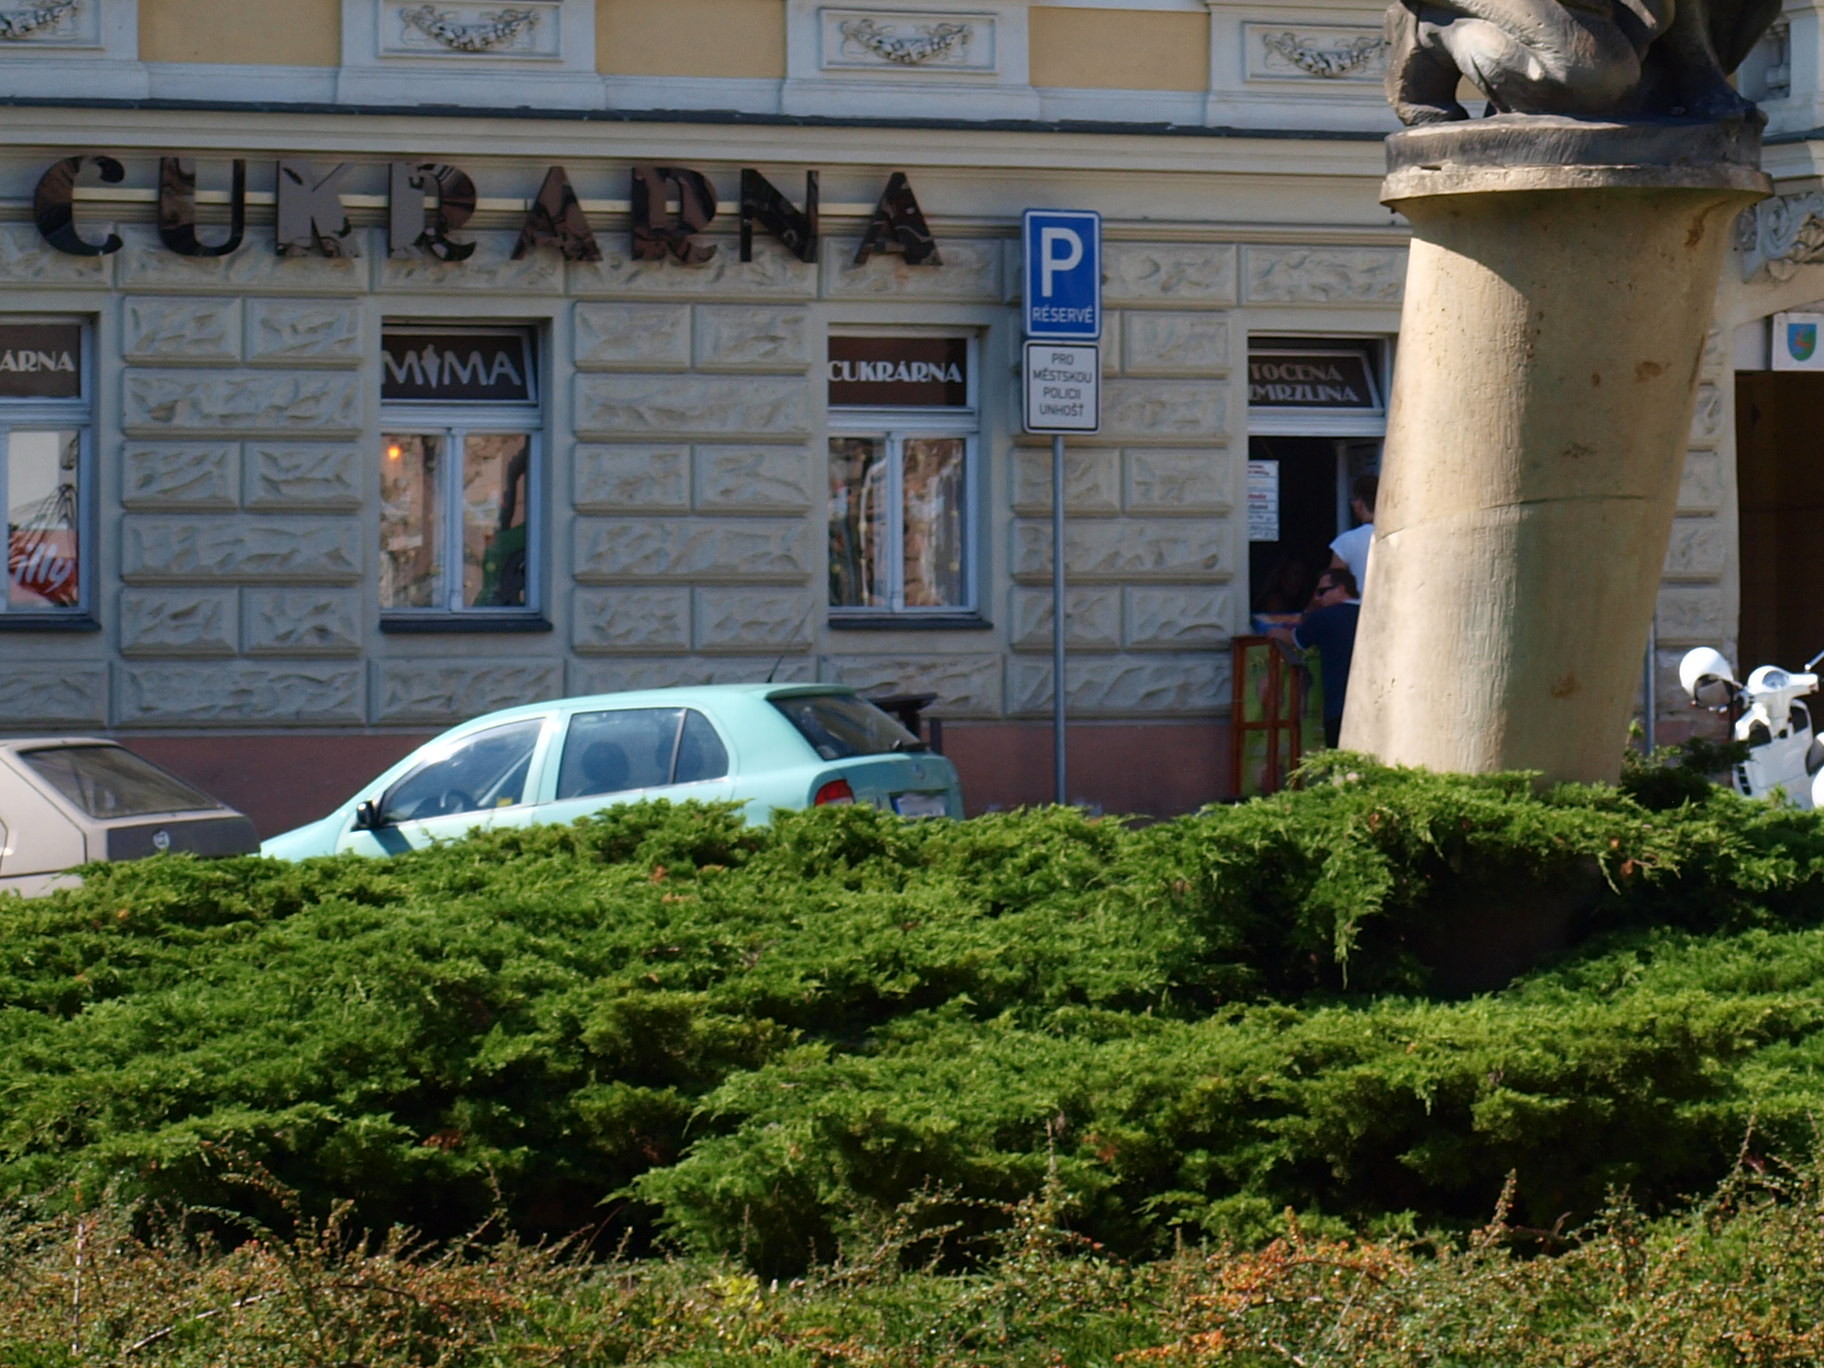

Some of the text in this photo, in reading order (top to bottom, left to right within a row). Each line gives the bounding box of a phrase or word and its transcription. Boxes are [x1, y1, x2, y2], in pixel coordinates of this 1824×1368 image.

[1041, 226, 1083, 297] P
[1032, 304, 1094, 324] RÉSERVÉ
[1051, 352, 1075, 365] PRO
[828, 360, 963, 383] CUKRÁRNA
[1033, 367, 1093, 383] MĚSTSKOU
